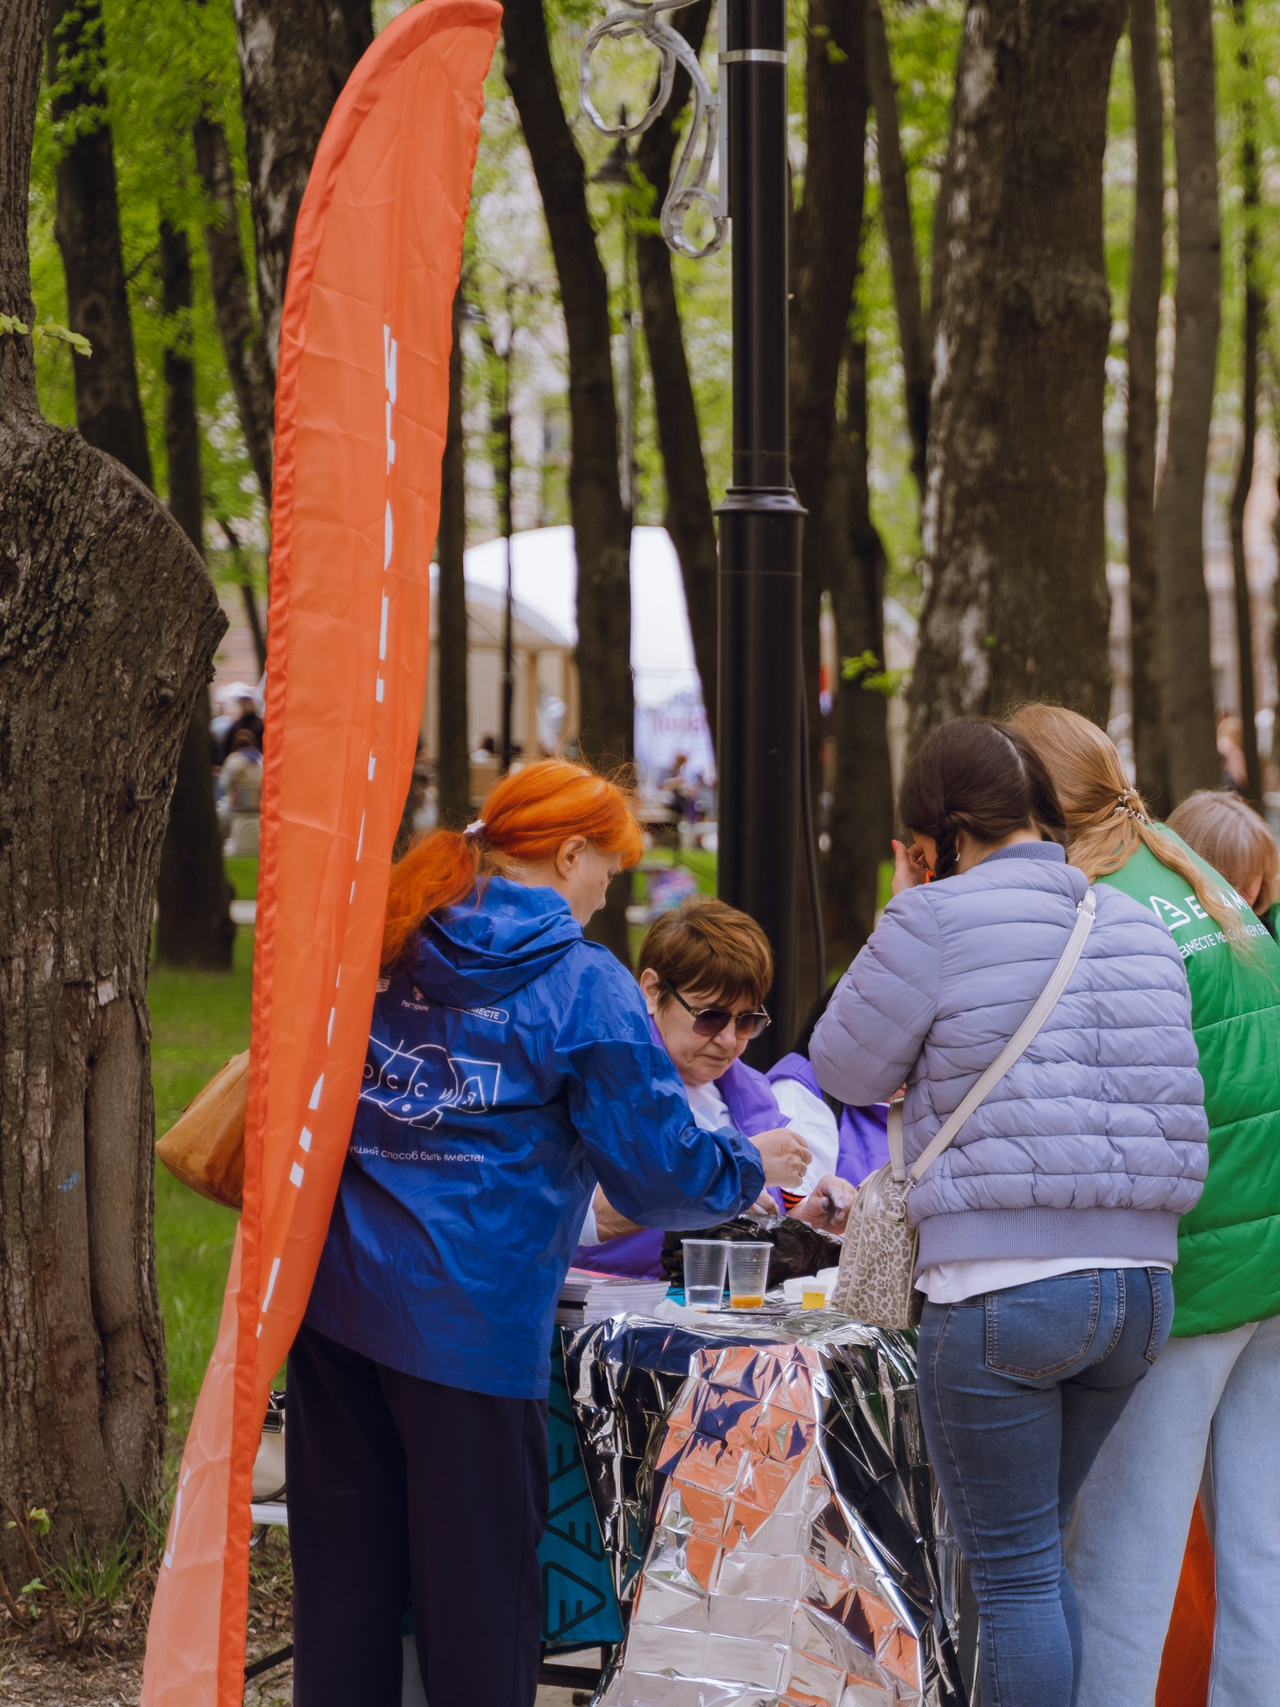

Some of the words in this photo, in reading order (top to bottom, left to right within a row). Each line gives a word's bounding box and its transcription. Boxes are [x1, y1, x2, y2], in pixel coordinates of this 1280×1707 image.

[1178, 934, 1217, 959] ВМЕСТЕ
[363, 1063, 477, 1107] ОССИЯ
[381, 1150, 418, 1161] способ
[420, 1151, 442, 1161] быть
[443, 1153, 485, 1163] вместе!
